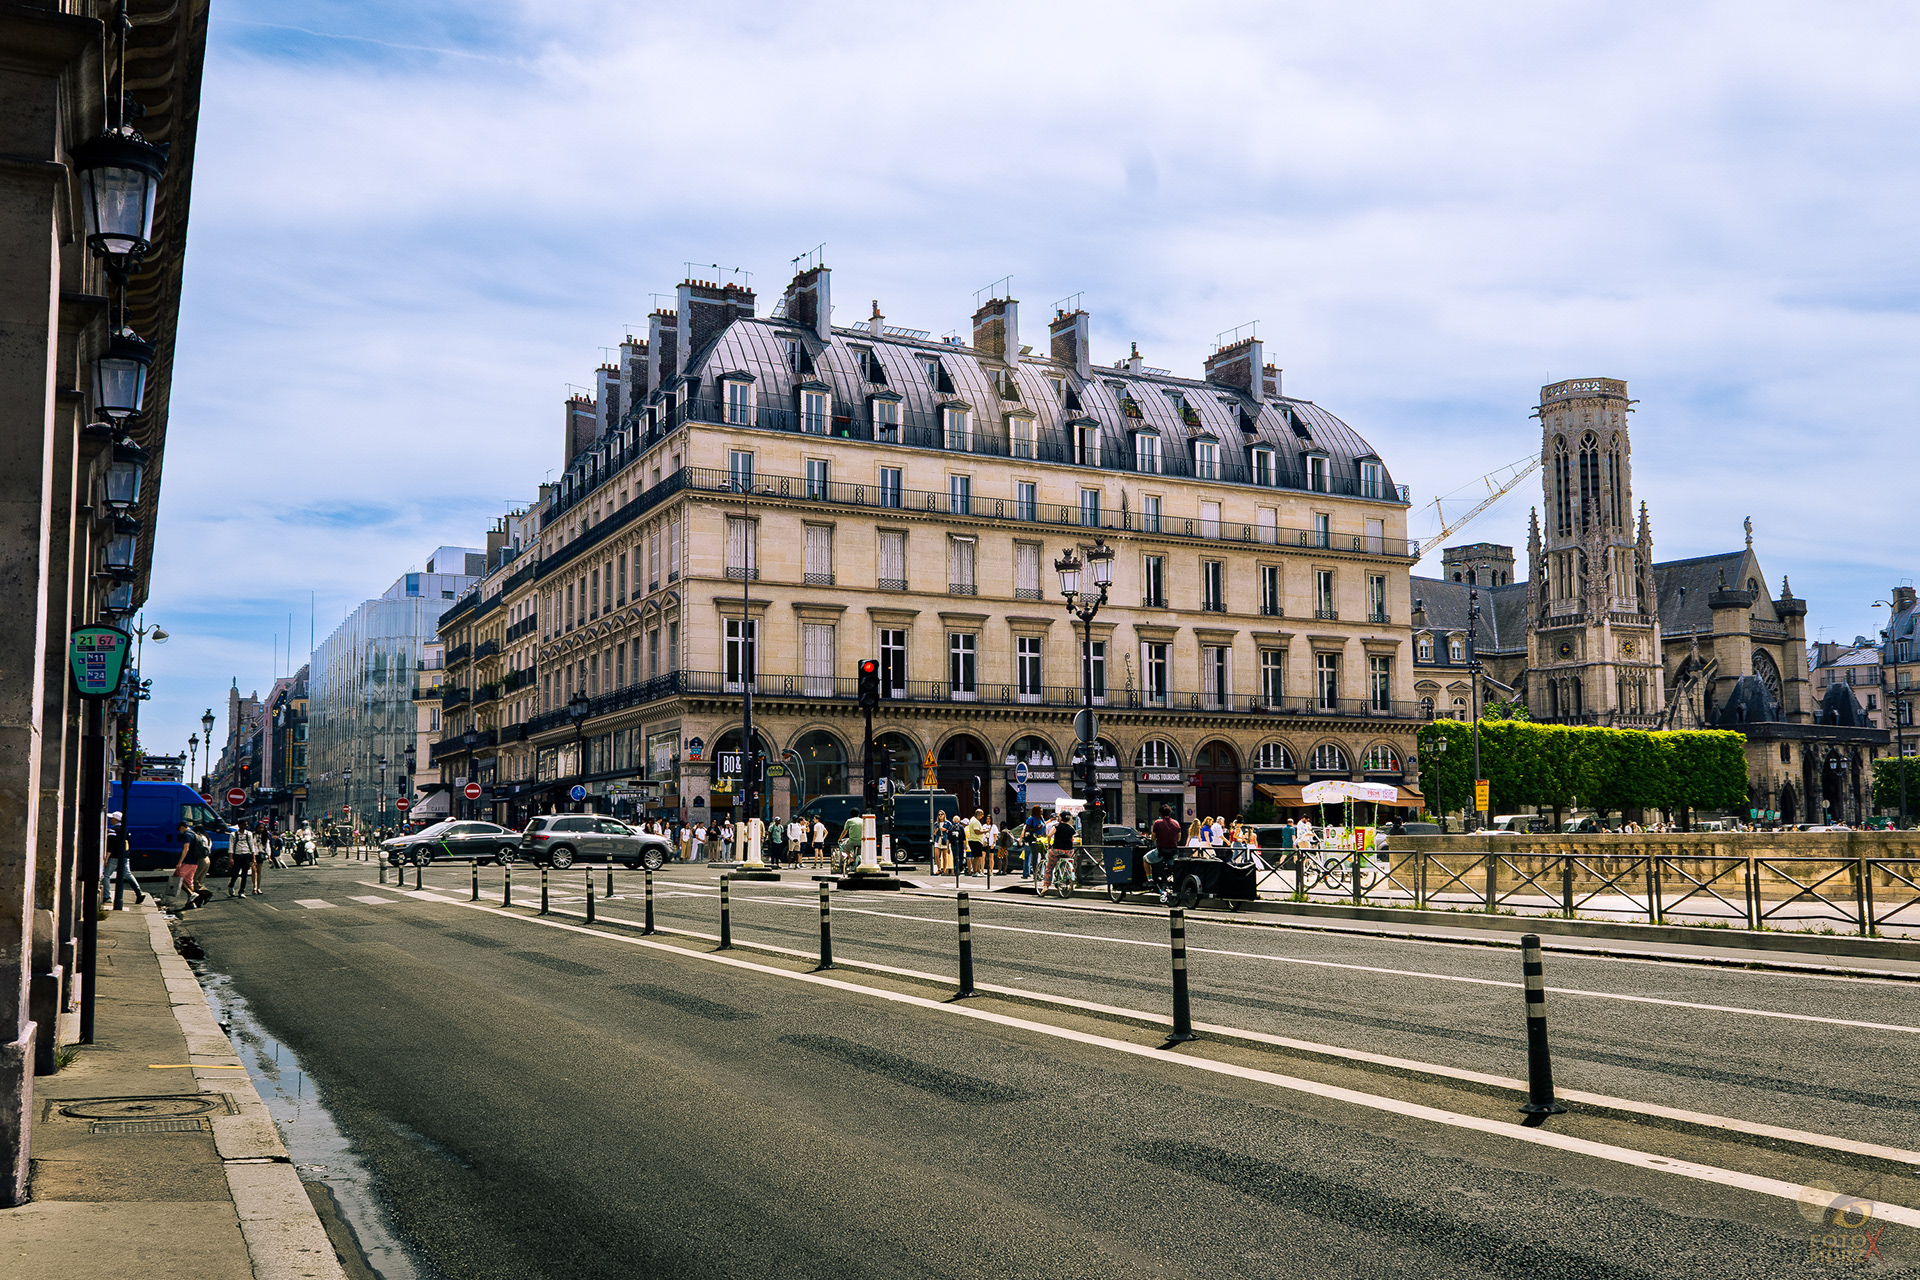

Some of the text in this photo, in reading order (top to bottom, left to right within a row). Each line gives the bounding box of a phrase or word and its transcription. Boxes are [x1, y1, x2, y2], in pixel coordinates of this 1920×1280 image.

[80, 636, 113, 645] 21 67
[1148, 773, 1160, 781] PARIS
[1160, 773, 1180, 781] TOURISME
